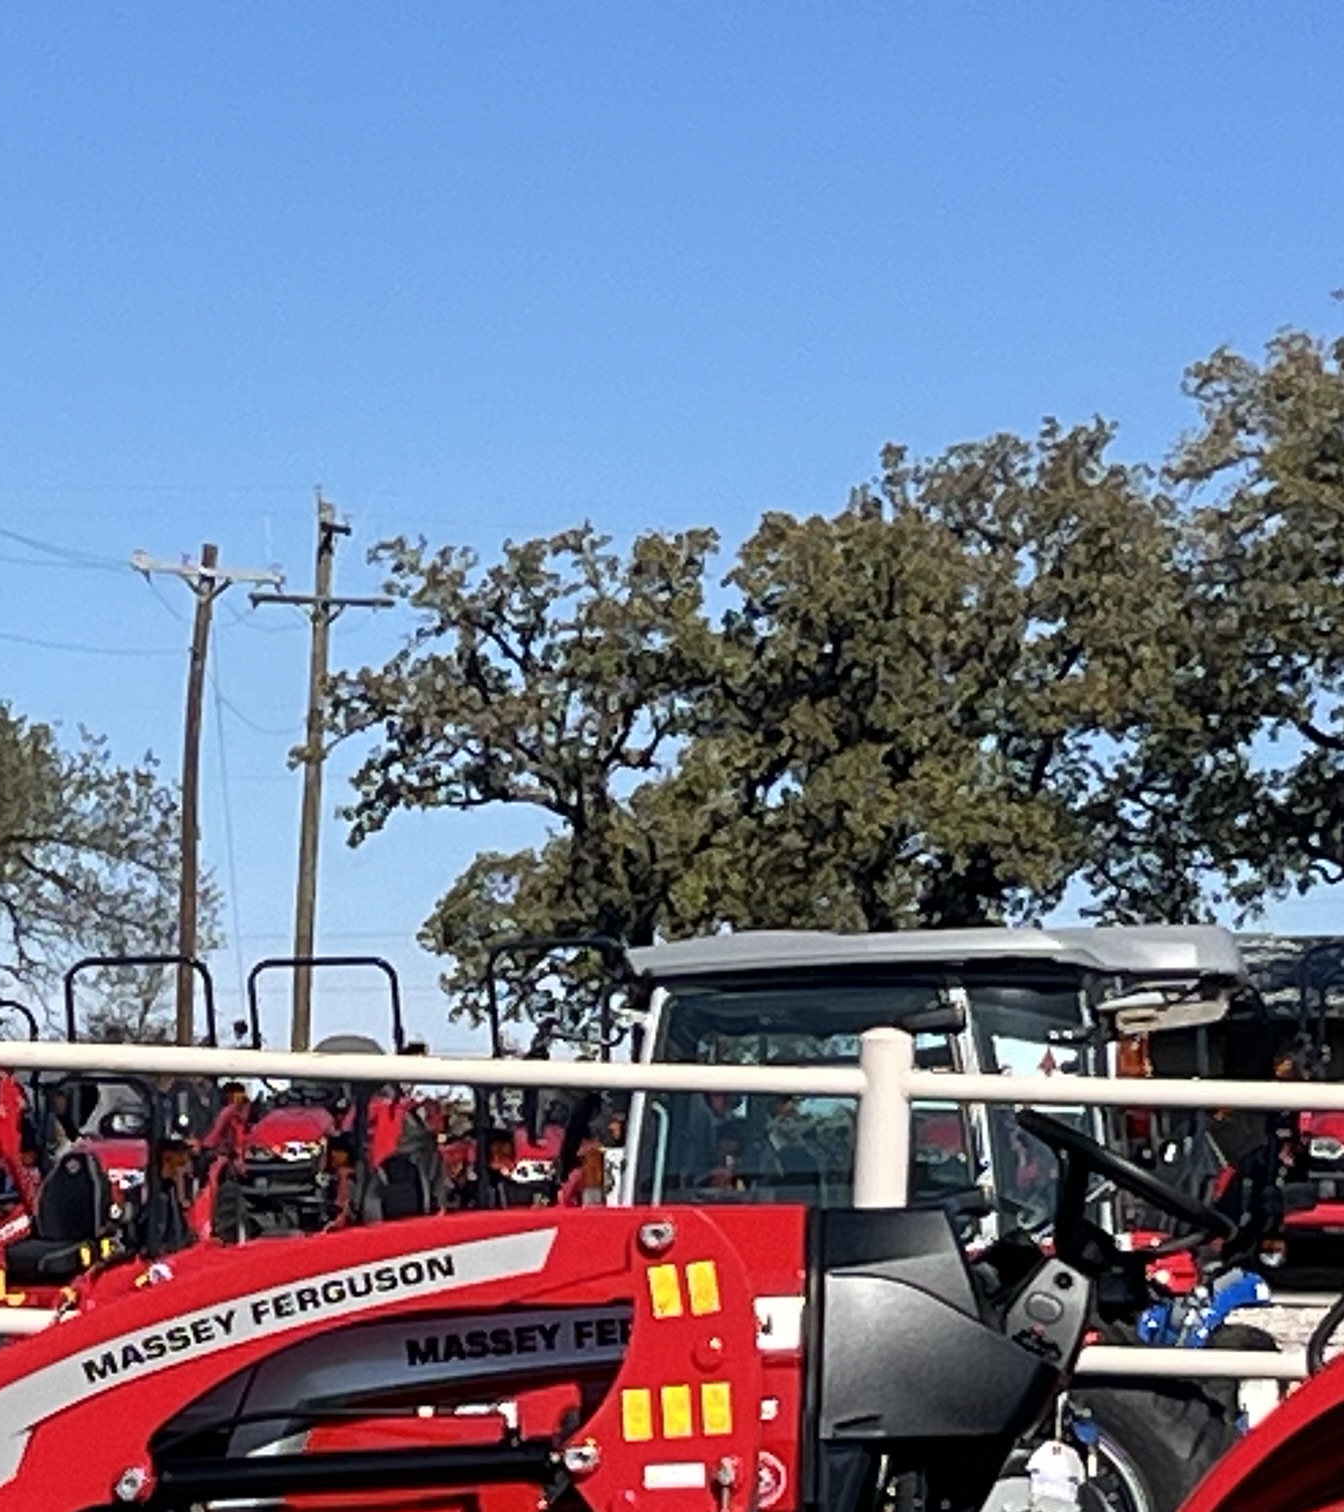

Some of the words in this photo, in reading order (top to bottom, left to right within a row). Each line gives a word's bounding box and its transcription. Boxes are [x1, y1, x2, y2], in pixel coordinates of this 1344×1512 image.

[82, 1310, 235, 1382] MASSEY
[250, 1255, 455, 1325] FERGUSON
[406, 1322, 561, 1366] MASSEY
